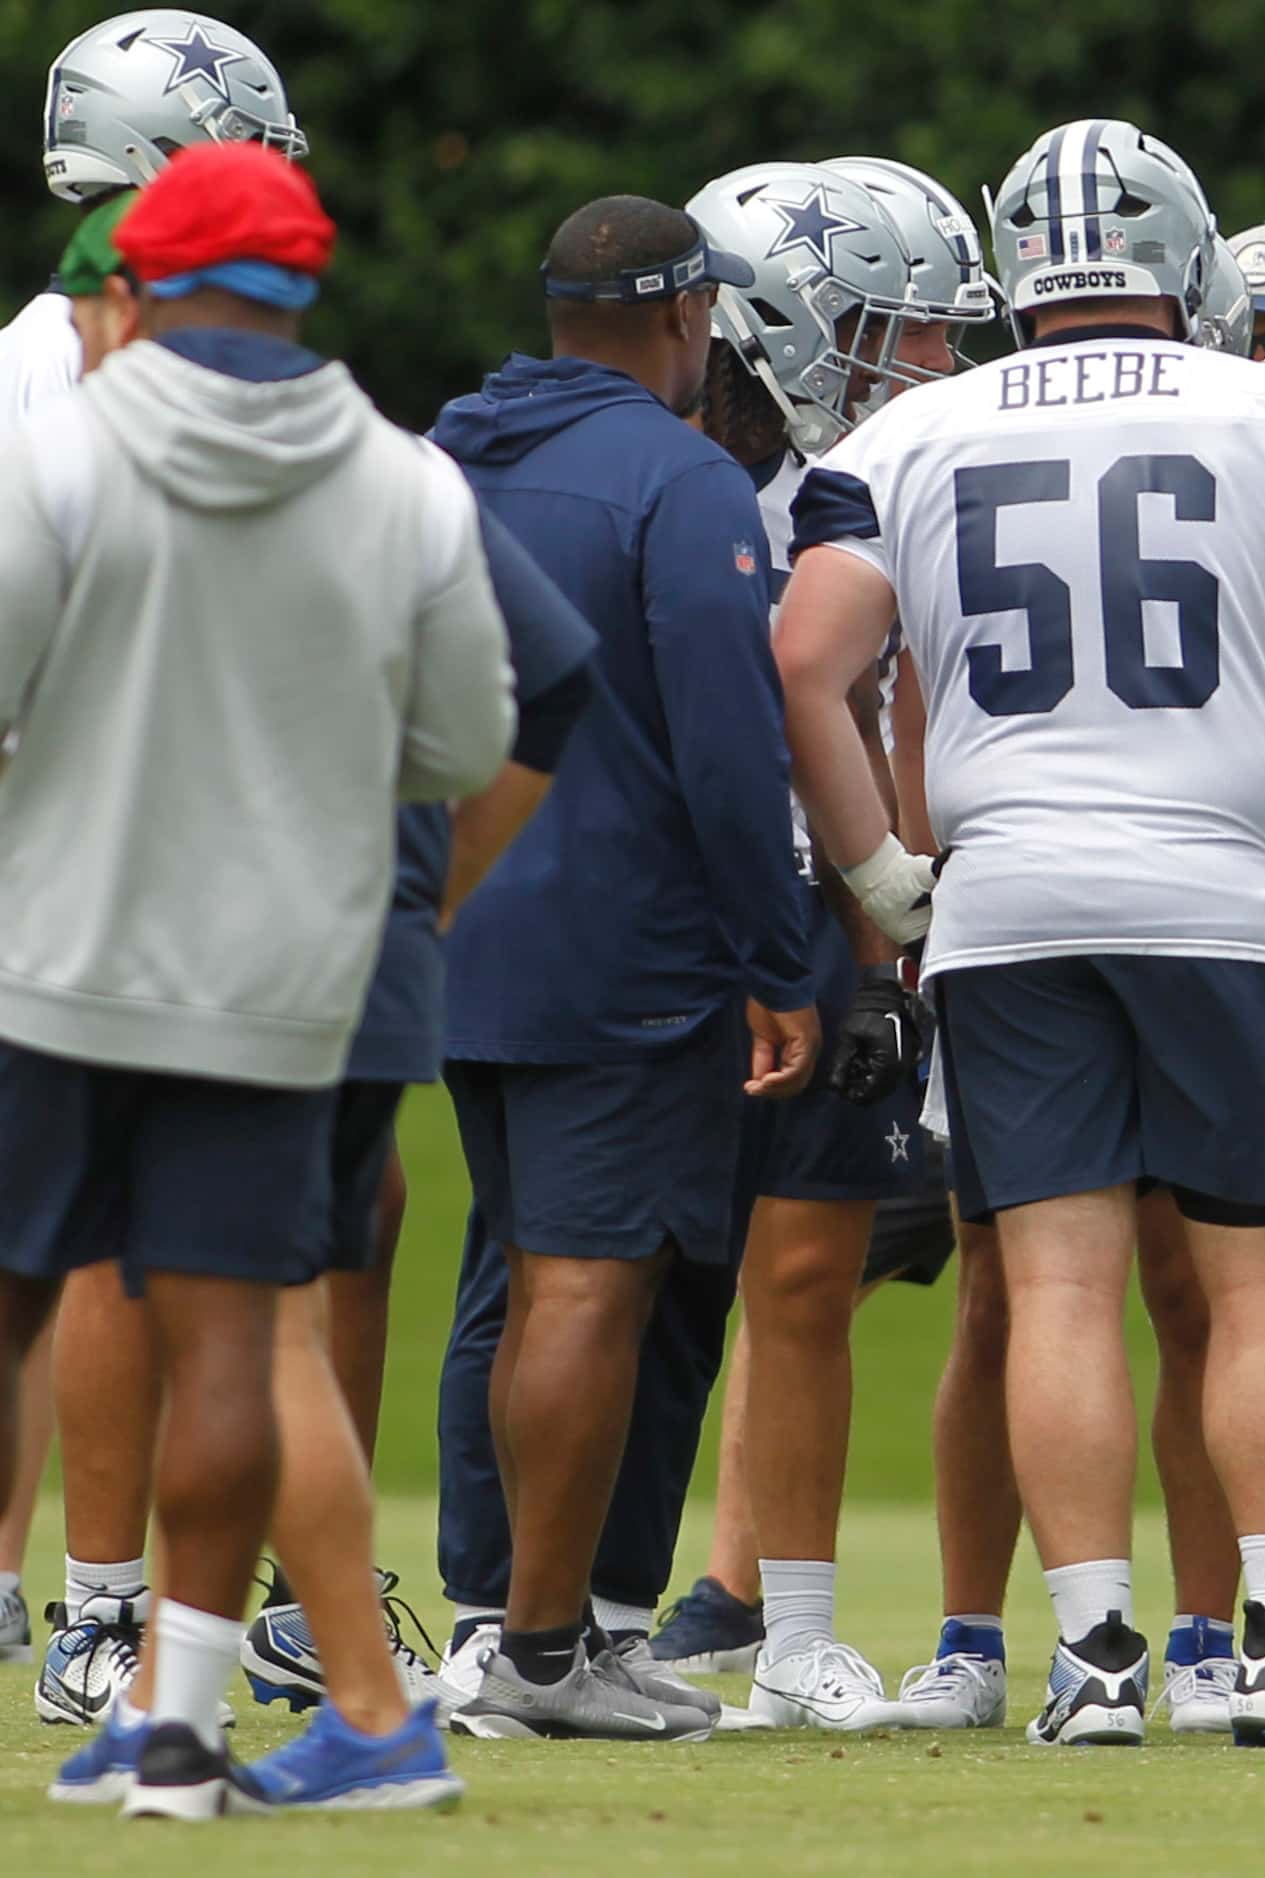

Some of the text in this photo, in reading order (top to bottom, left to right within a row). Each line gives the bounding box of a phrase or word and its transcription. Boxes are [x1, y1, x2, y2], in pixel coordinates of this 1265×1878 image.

[1033, 271, 1126, 295] COWBOYS
[998, 351, 1185, 411] BEEBE
[954, 454, 1220, 717] 56
[1107, 1712, 1126, 1727] 56
